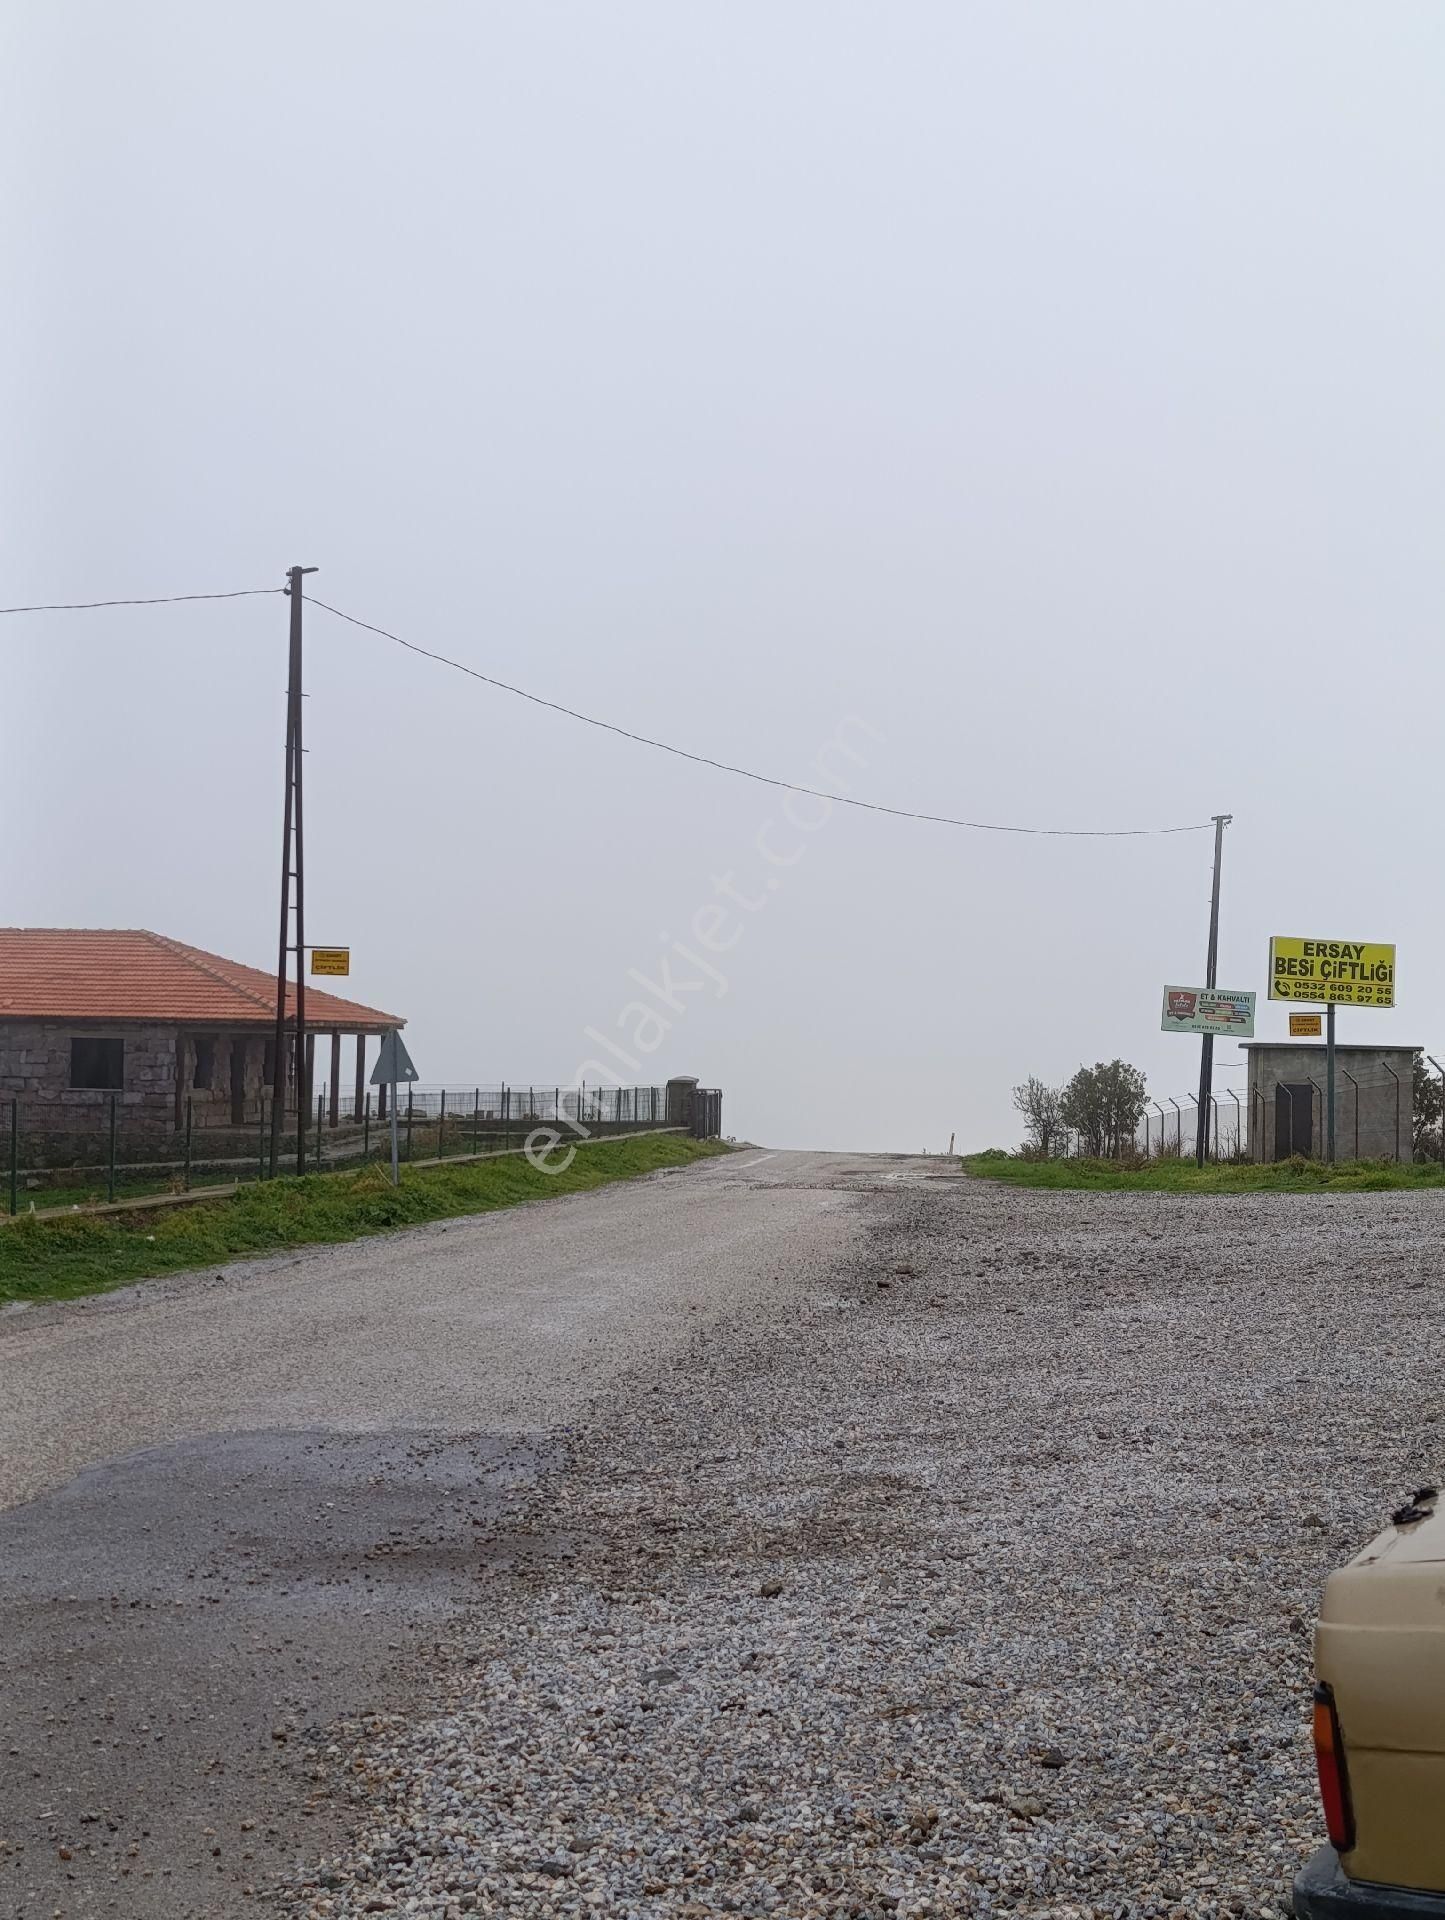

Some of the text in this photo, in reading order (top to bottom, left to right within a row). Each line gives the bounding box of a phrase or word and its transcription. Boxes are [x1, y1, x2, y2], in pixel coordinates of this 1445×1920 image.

[1304, 942, 1365, 959] ERSAY
[1294, 982, 1326, 990] 0532
[1357, 985, 1373, 993] 20
[1217, 994, 1250, 1003] KAHVALTI
[1293, 991, 1326, 1000] 0554
[1329, 992, 1353, 1002] 863
[1356, 995, 1373, 1003] 97
